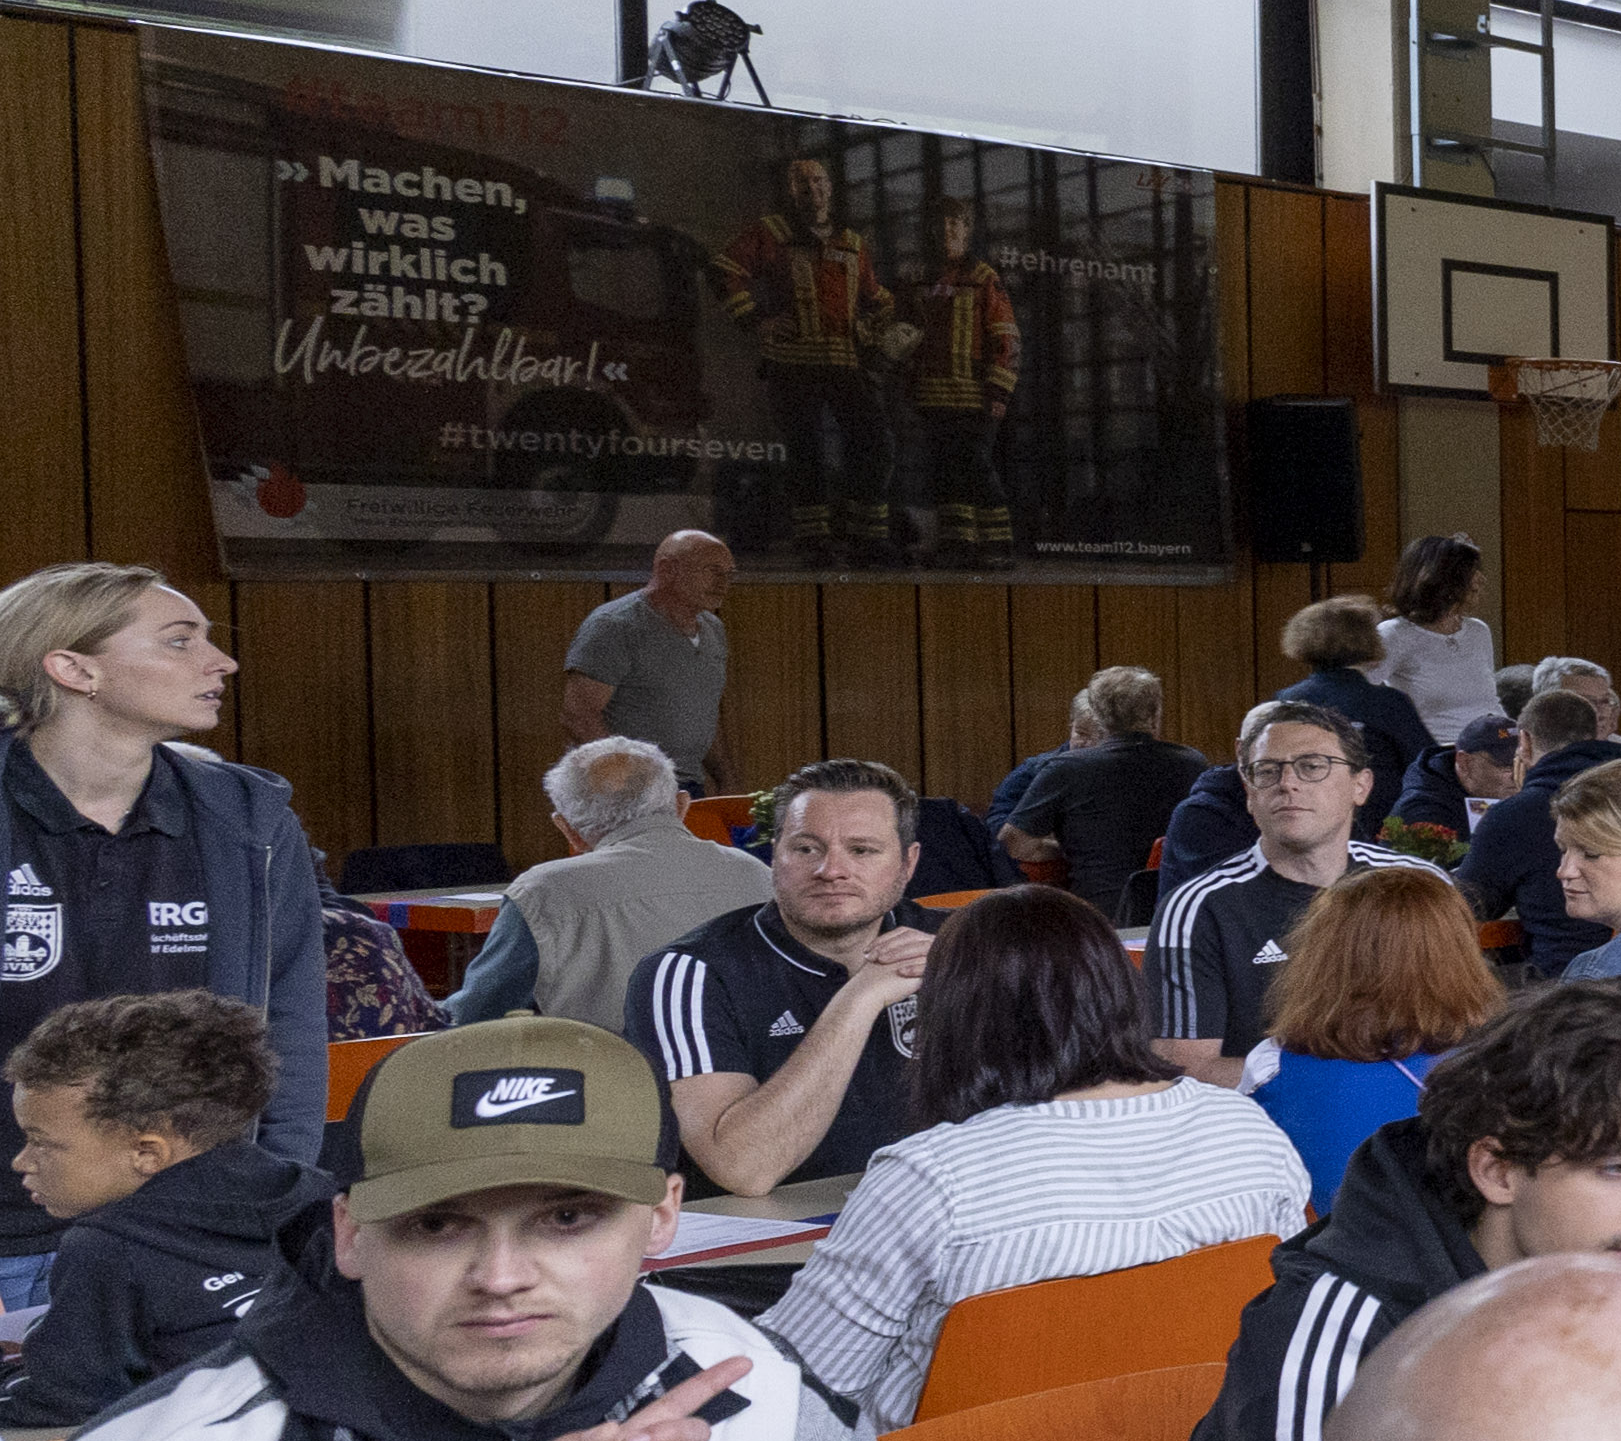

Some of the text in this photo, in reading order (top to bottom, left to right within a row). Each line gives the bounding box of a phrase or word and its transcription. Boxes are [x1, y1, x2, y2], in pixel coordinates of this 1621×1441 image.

[359, 207, 455, 242] was
[304, 240, 508, 287] wirklich
[1001, 246, 1157, 285] #ehrenamt
[330, 285, 489, 326] zählt?
[438, 422, 789, 463] #twentyfourseven
[1036, 540, 1192, 558] www.team112.bayern
[8, 884, 53, 897] didas
[148, 901, 208, 927] ERG
[1252, 953, 1289, 965] adidas
[768, 1023, 806, 1038] adidas
[491, 1077, 556, 1103] NIKE
